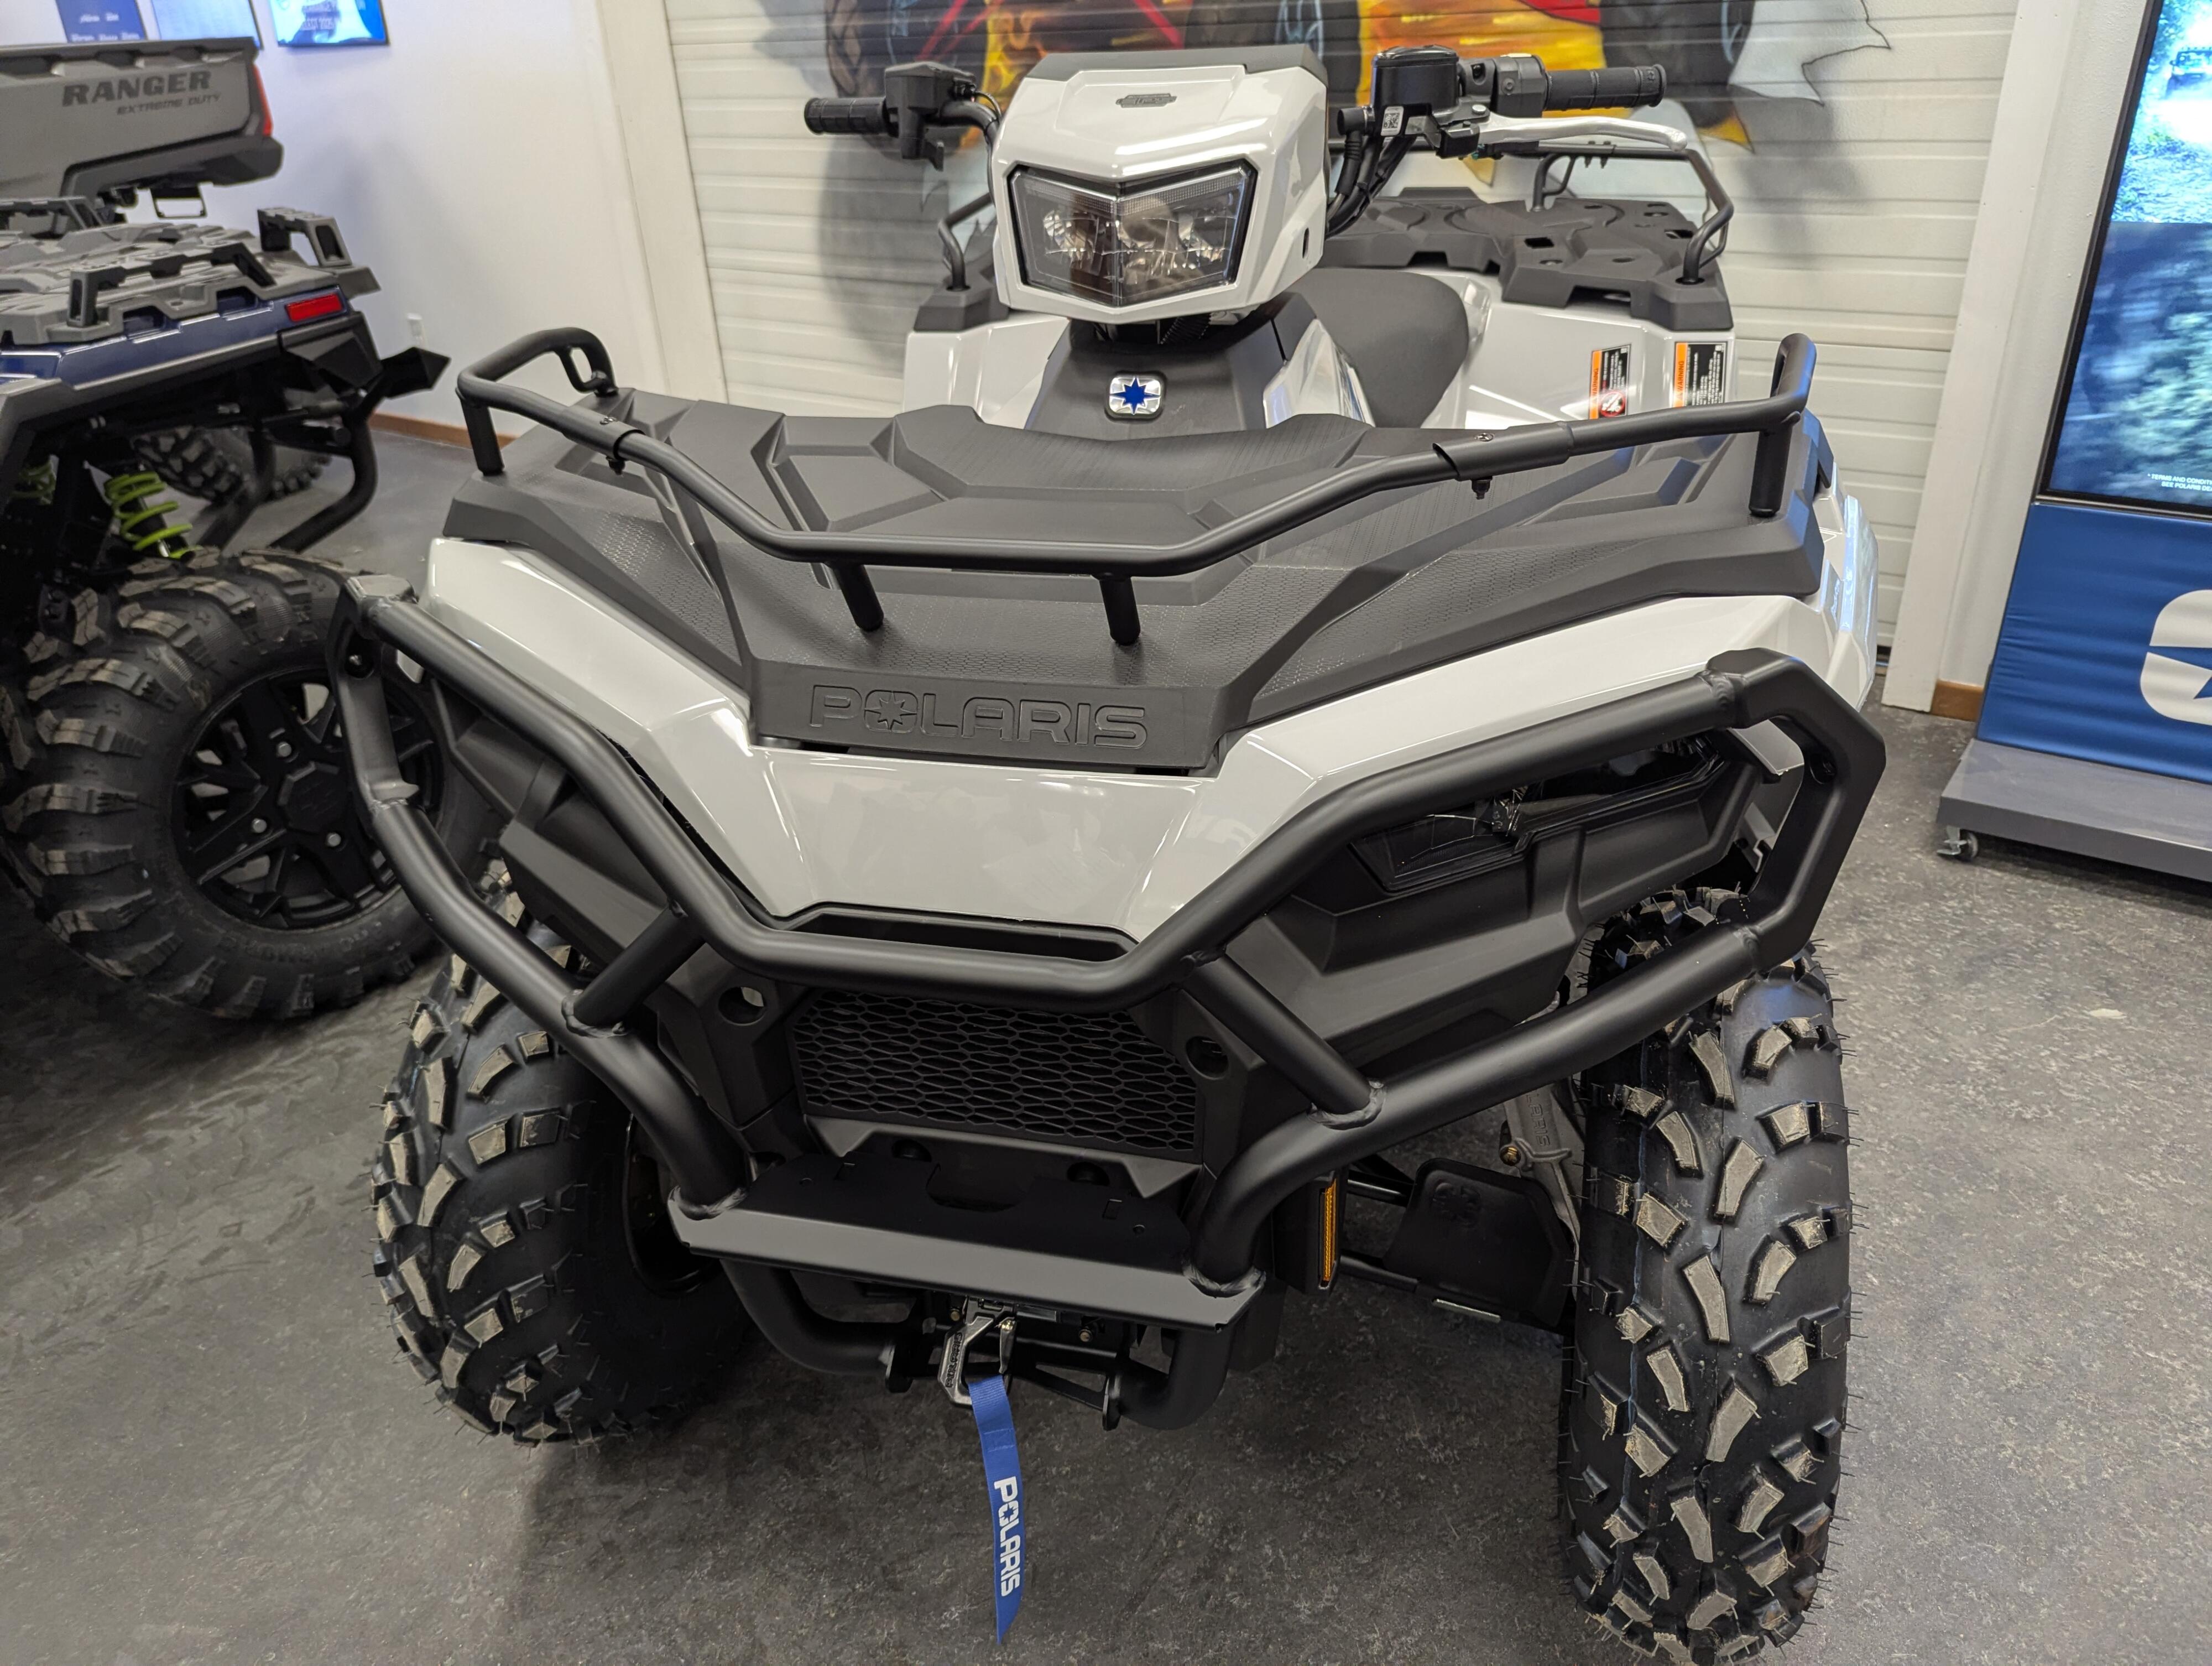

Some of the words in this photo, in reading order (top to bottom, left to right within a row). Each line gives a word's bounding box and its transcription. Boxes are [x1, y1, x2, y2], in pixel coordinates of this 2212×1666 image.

[62, 70, 211, 107] RANGER
[117, 98, 183, 115] EXTREME
[188, 94, 221, 106] DUTY
[2174, 482, 2201, 491] POLARIS
[809, 684, 1147, 749] POLARIS
[994, 1476, 1021, 1597] POLARIS
